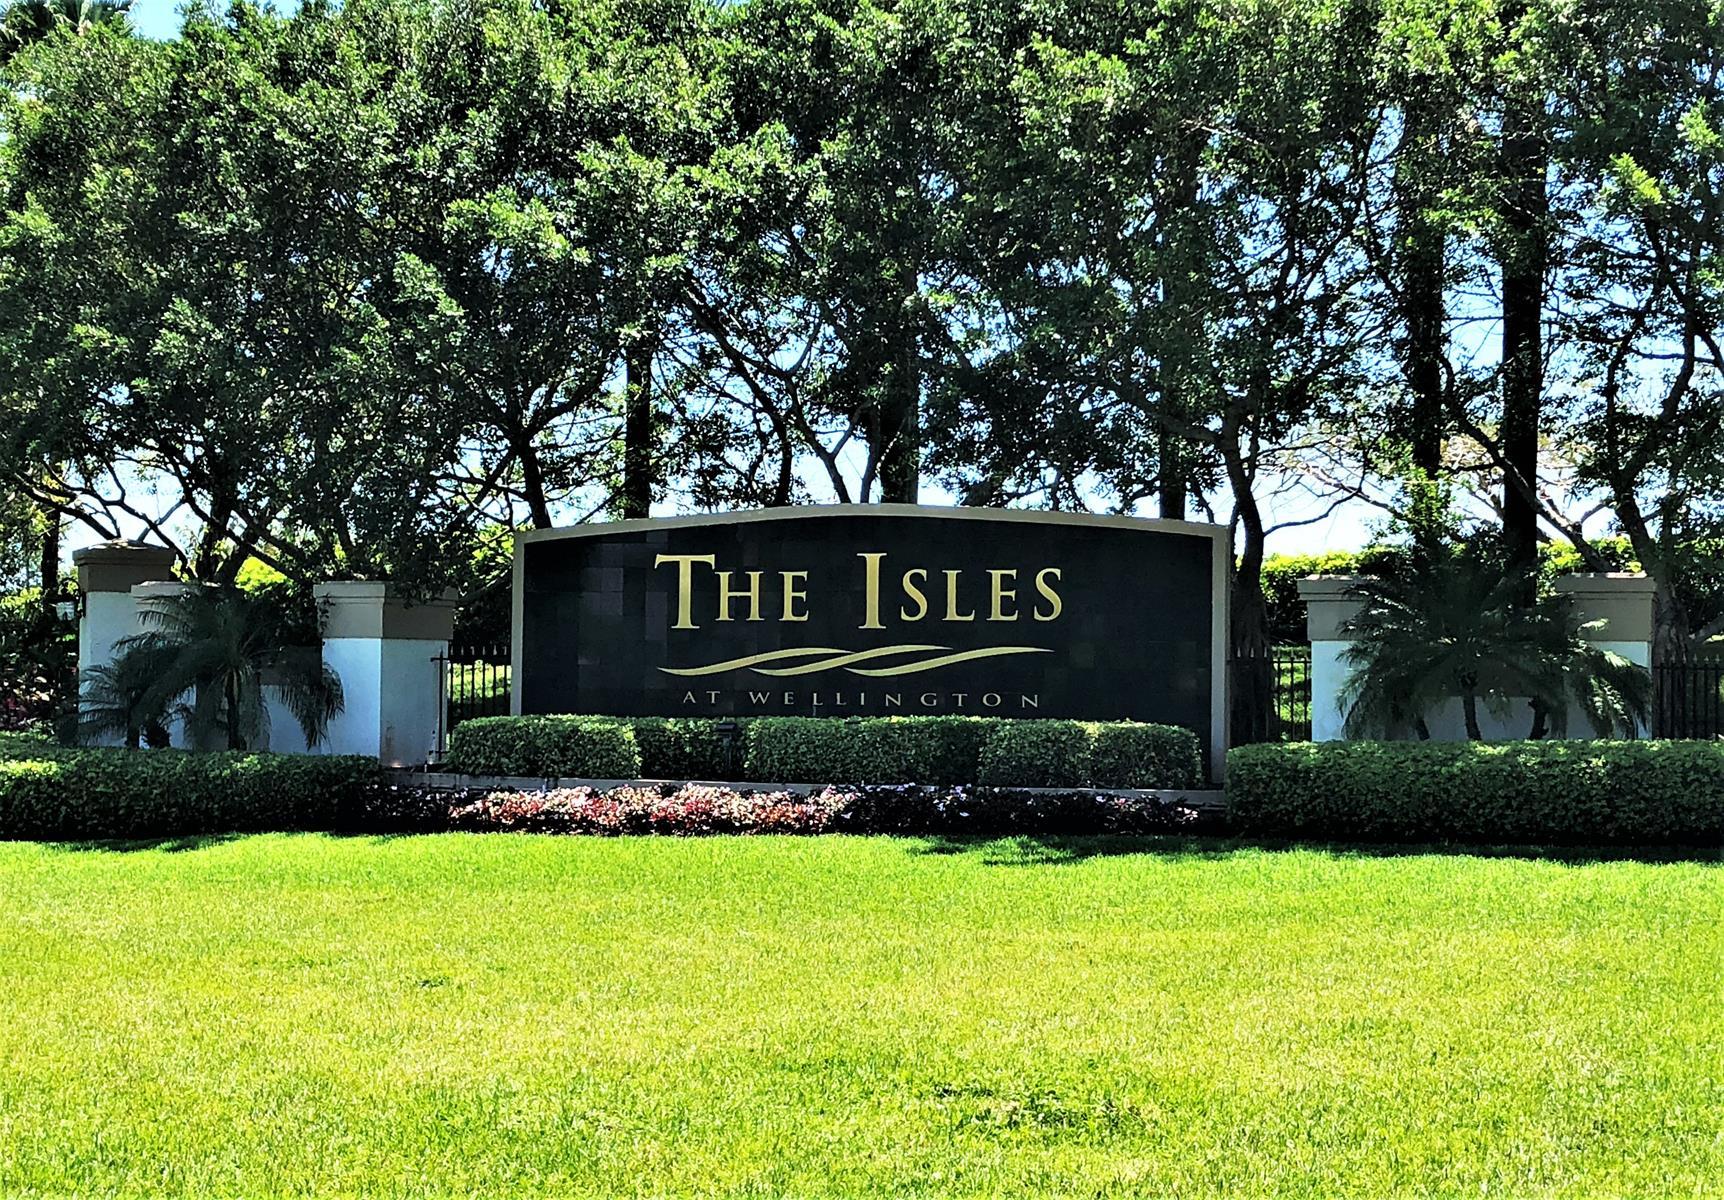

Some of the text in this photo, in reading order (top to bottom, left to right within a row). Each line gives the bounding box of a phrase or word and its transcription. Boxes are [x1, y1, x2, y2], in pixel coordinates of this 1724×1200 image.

[654, 552, 1063, 629] THE ISLES
[682, 690, 1039, 708] AT WELLINGTON
